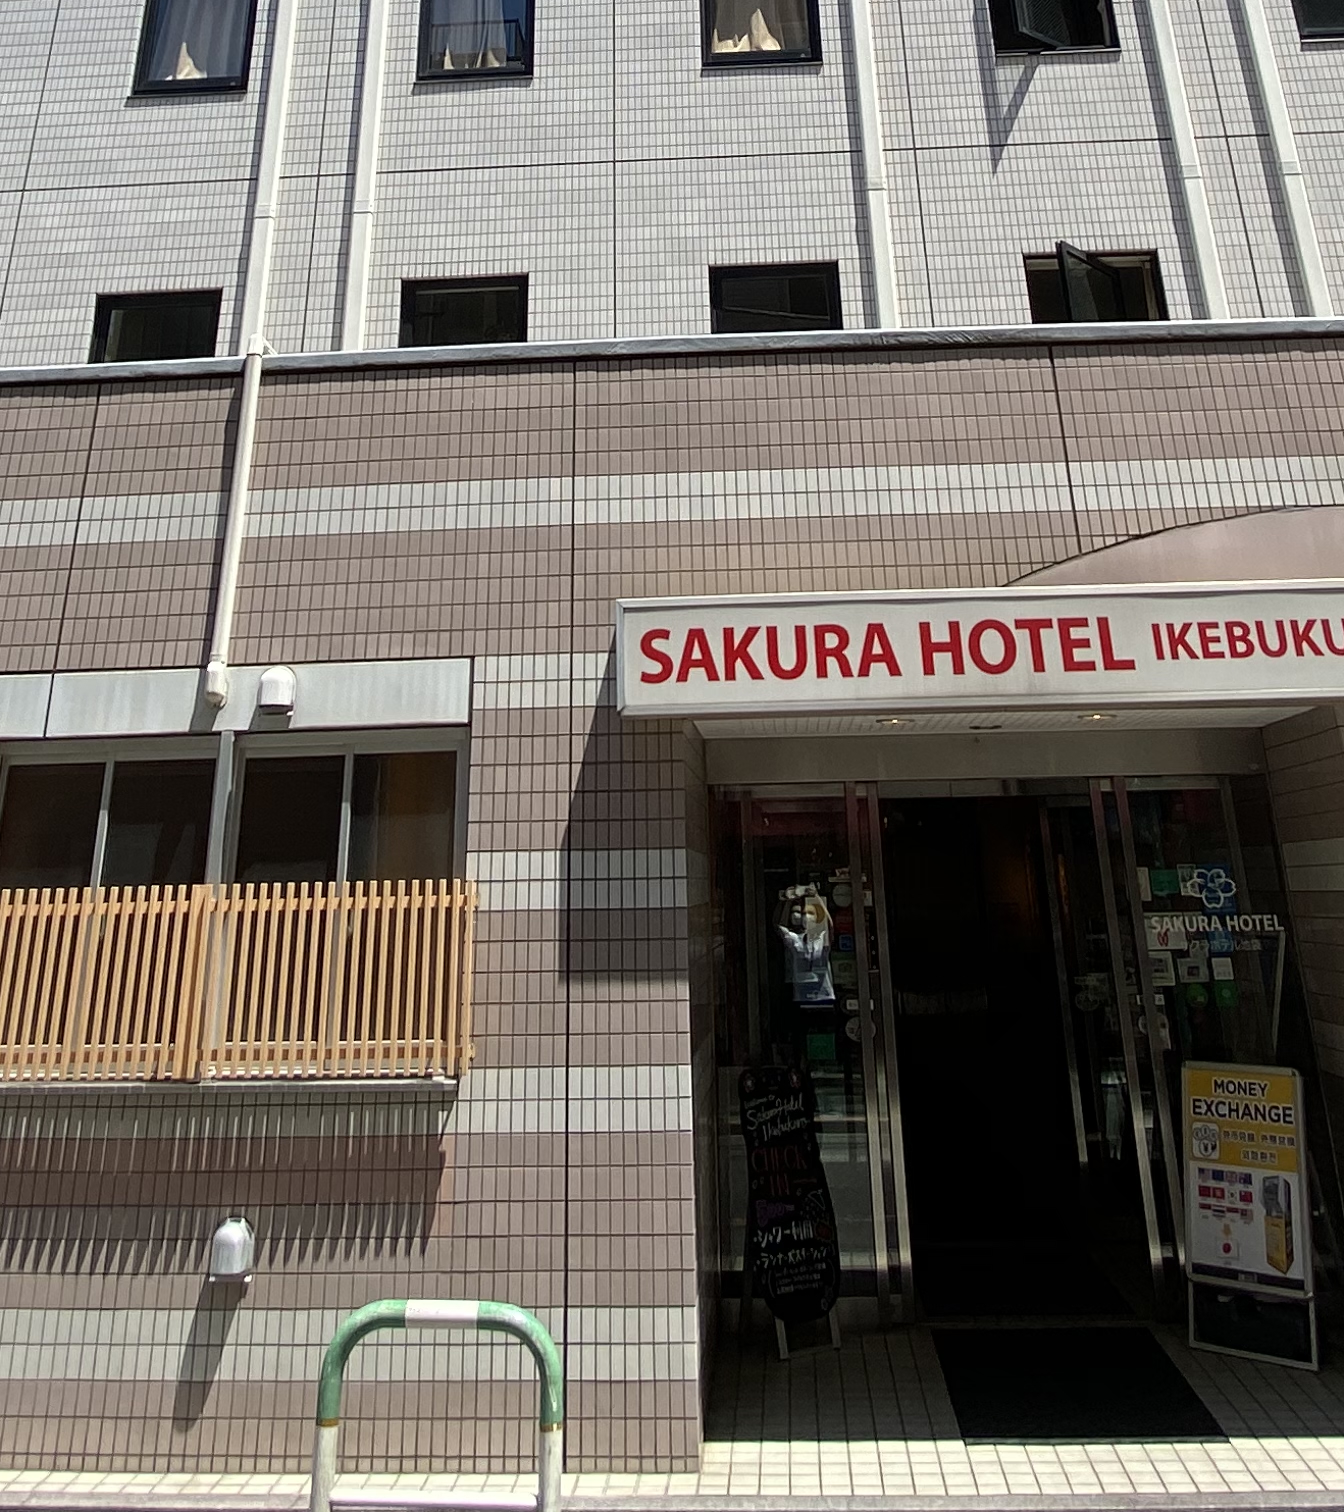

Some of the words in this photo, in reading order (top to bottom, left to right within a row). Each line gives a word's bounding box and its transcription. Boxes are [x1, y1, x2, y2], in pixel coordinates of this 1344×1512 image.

[638, 622, 903, 684] SAKURA
[919, 616, 1135, 677] HOTEL
[1150, 914, 1224, 932] SAKURA
[1226, 913, 1285, 931] HOTEL
[1213, 1078, 1269, 1098] MONEY
[1191, 1098, 1294, 1125] EXCHANGE
